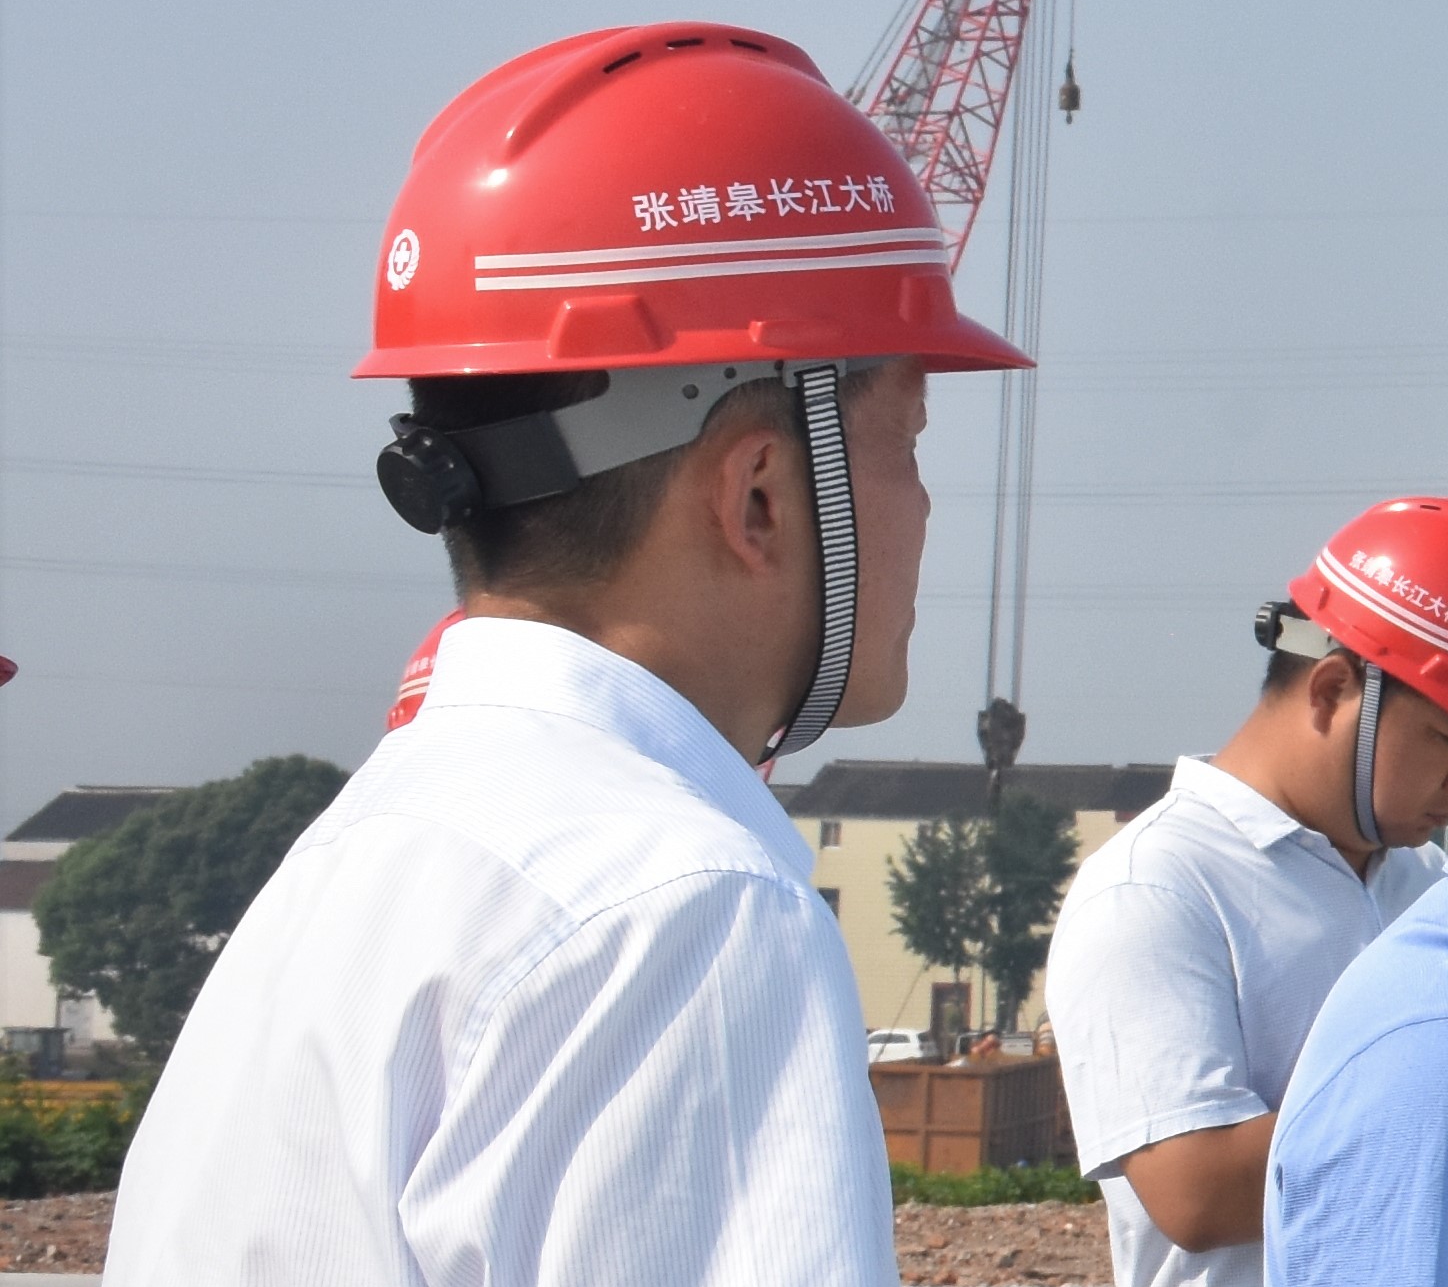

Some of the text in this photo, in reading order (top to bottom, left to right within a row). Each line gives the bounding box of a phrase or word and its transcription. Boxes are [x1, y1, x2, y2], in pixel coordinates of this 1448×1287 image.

[631, 174, 895, 232] 张靖皋长江大桥
